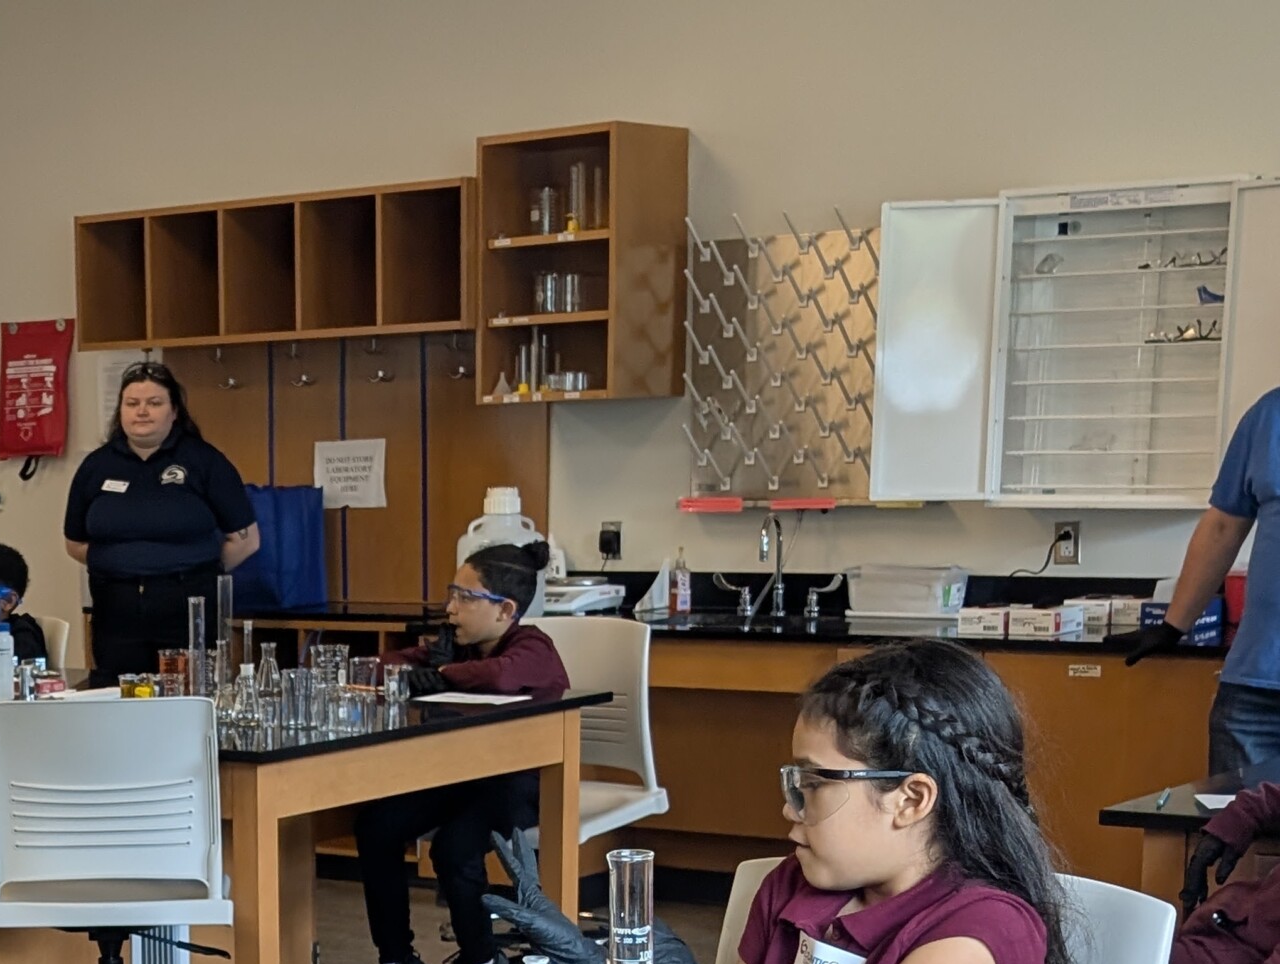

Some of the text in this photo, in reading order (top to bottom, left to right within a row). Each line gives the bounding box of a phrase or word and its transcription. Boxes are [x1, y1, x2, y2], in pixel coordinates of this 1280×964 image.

[336, 456, 350, 464] NOT
[326, 465, 372, 474] LABORATORY
[330, 474, 370, 484] EQUIPMENT
